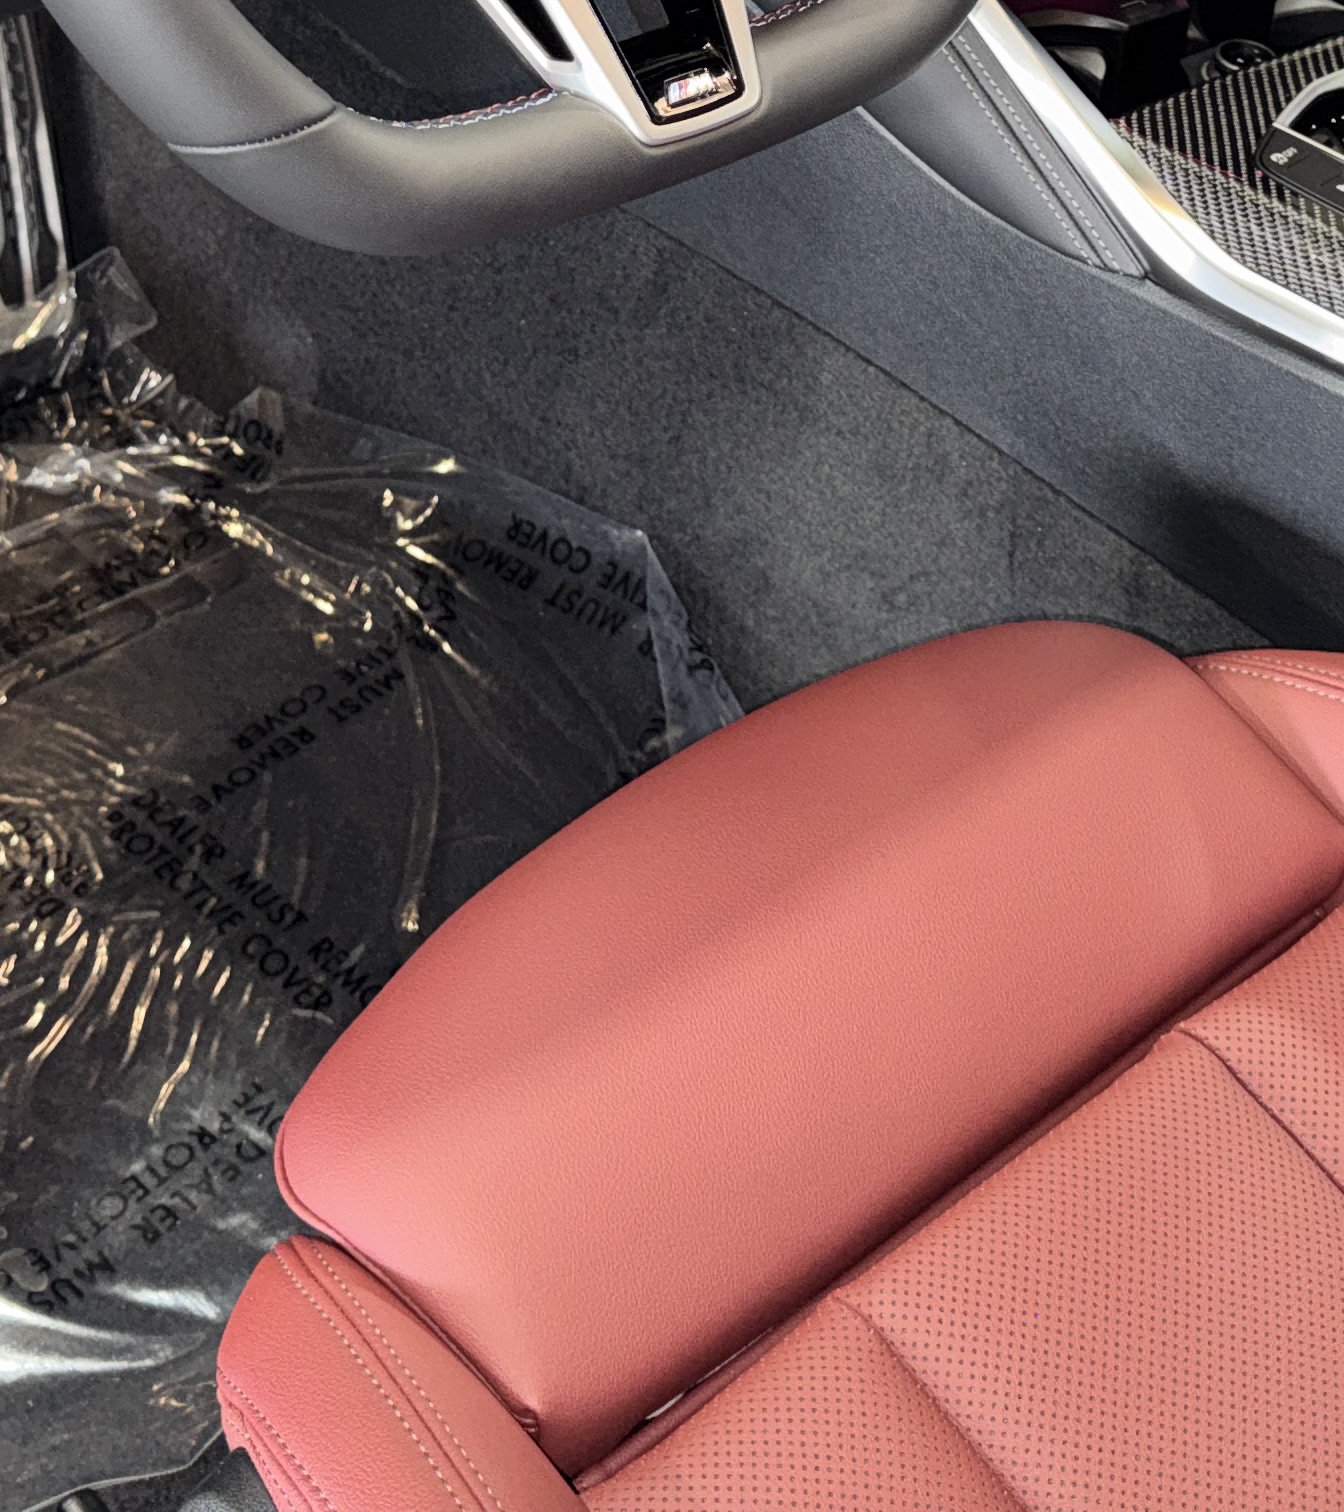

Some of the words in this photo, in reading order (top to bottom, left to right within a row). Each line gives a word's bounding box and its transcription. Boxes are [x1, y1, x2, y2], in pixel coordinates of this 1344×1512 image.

[506, 511, 593, 574] COVER
[544, 580, 630, 639] MUST
[229, 683, 328, 751] COVER
[325, 666, 406, 726] MUST
[189, 724, 317, 815] REMOVE
[106, 809, 247, 936] PROTECTIVE
[241, 931, 335, 1011] COVER
[226, 869, 309, 932] MUST
[307, 935, 384, 1008] REMO
[129, 1136, 268, 1247] DEALER
[25, 1249, 118, 1311] MUS
